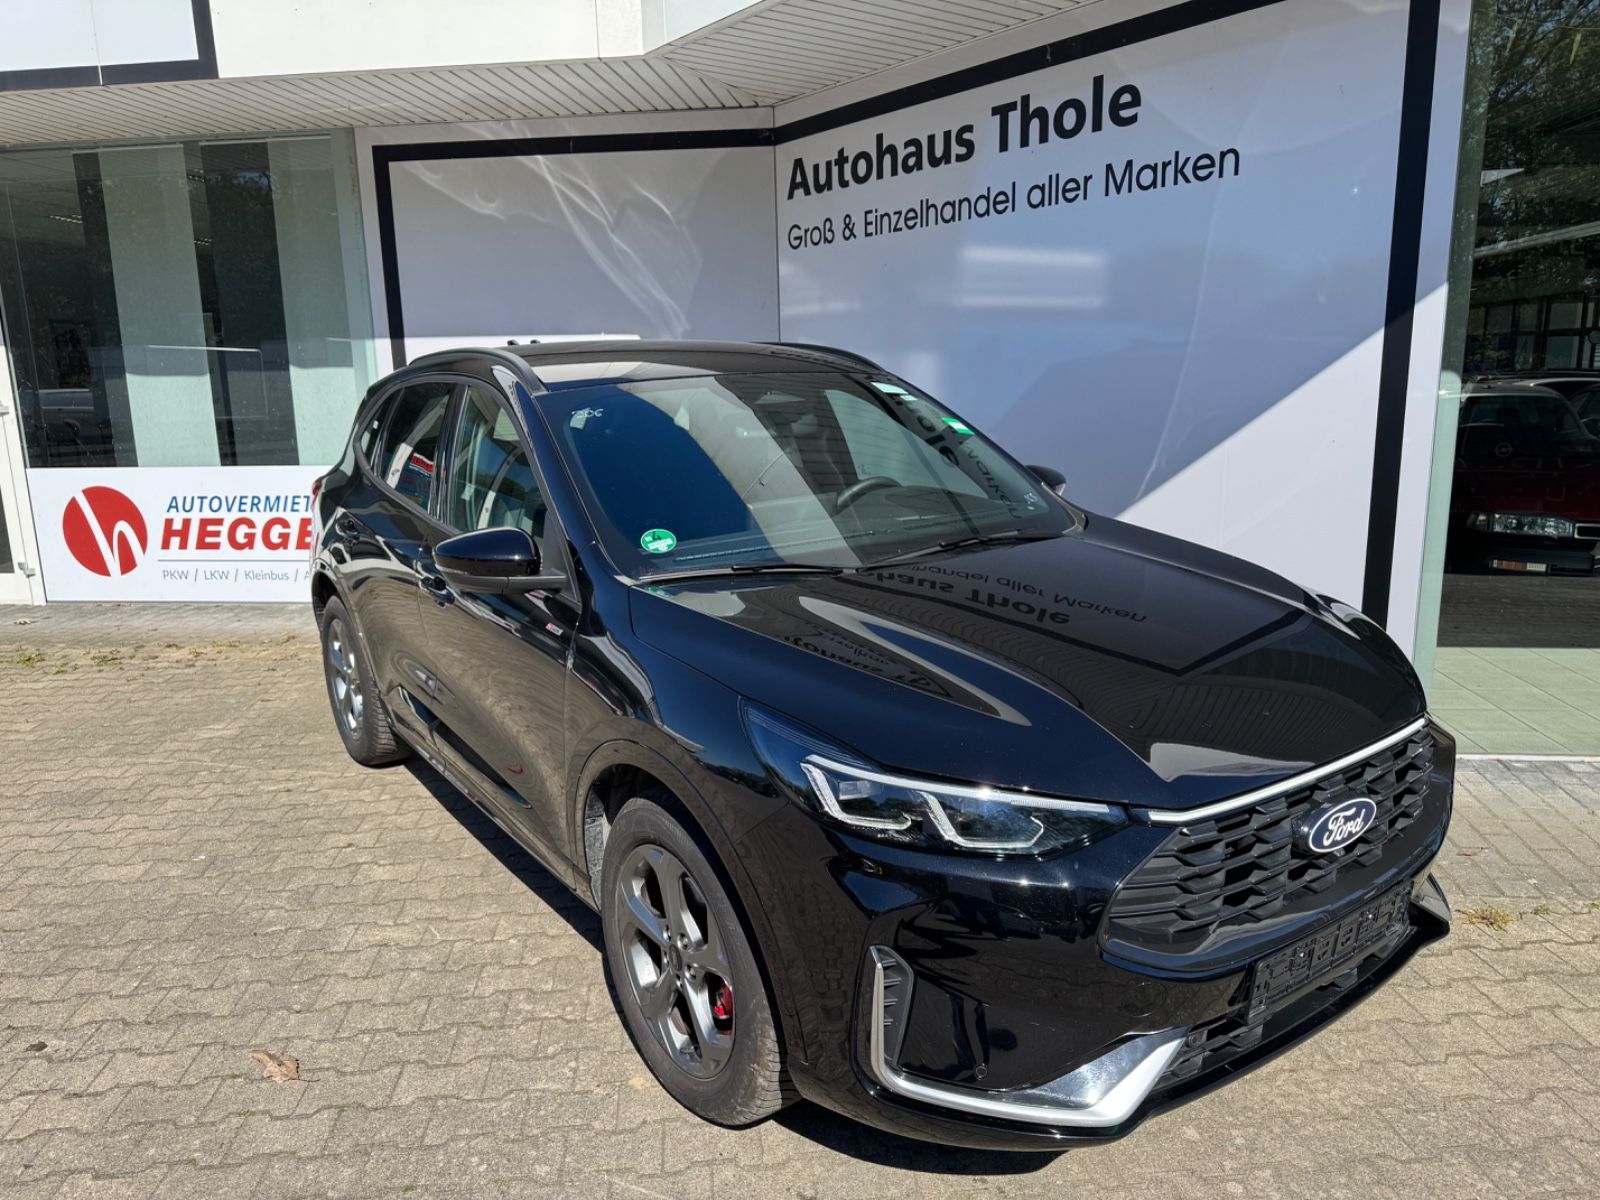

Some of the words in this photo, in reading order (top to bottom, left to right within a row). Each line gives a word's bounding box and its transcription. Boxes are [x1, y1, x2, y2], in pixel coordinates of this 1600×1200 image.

[787, 122, 975, 200] Autohaus
[991, 74, 1141, 154] Thole
[787, 216, 836, 250] Groß
[842, 214, 857, 241] &
[863, 181, 1017, 238] Einzelhandel
[1026, 172, 1093, 209] aller
[1104, 147, 1240, 197] Marken
[166, 495, 311, 513] AUTOVERMIET
[160, 516, 312, 551] HEGGE
[162, 569, 189, 581] PKW
[203, 569, 230, 581] LKW
[244, 569, 290, 581] Kleinbus
[1322, 806, 1366, 847] Ford
